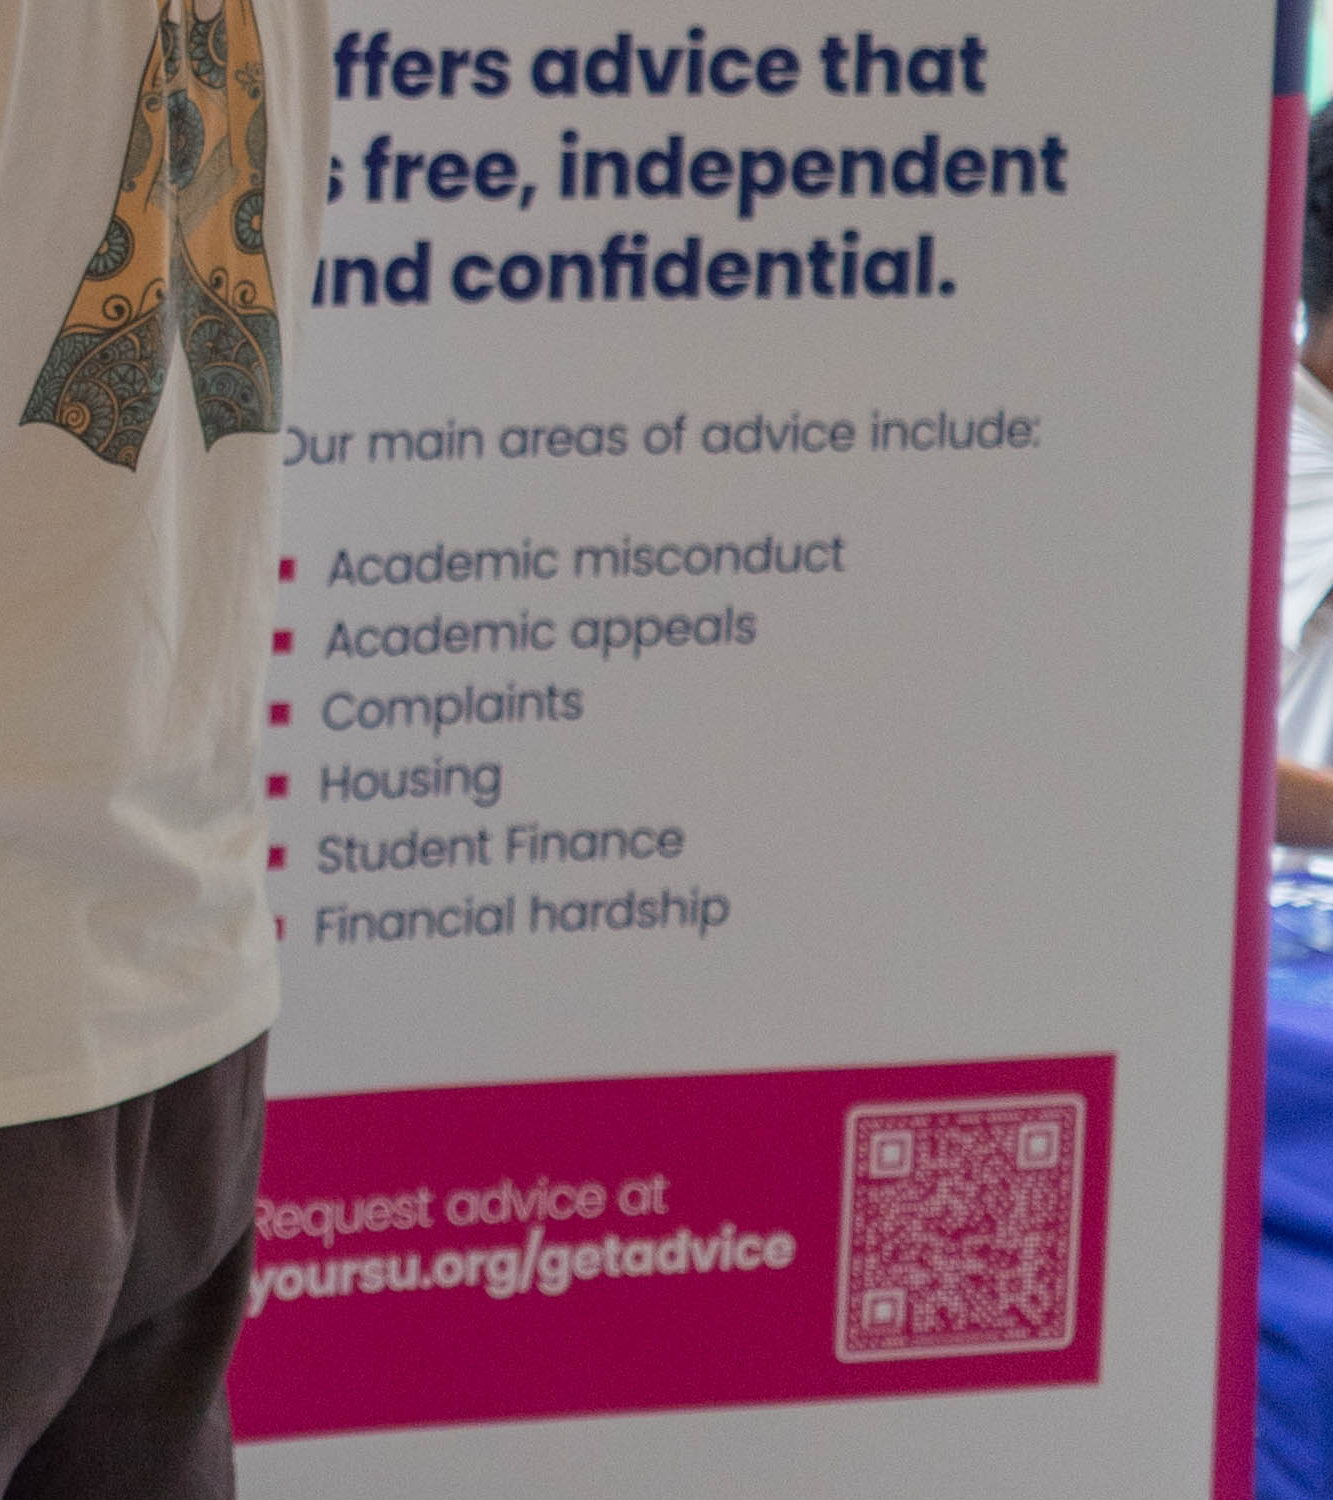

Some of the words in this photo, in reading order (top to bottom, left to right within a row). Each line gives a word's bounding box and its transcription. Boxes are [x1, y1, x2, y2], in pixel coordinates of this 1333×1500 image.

[334, 31, 510, 99] ffers
[531, 27, 800, 96] advice
[820, 33, 987, 95] that
[363, 135, 536, 210] free,
[561, 130, 1067, 220] independent
[451, 229, 955, 302] confidential.
[368, 420, 484, 462] main
[499, 423, 628, 458] areas
[643, 413, 687, 455] of
[701, 412, 856, 455] advice
[871, 410, 1039, 451] include:
[328, 538, 558, 587] Academic
[574, 534, 845, 577] misconduct
[325, 610, 556, 659] Academic
[570, 606, 756, 661] appeals
[321, 683, 584, 738] Complaints
[320, 756, 502, 808] Housing
[318, 828, 490, 874] Student
[506, 822, 685, 863] Finance
[315, 896, 515, 945] Financial
[530, 887, 730, 939] hardship
[254, 1187, 434, 1248] Request
[446, 1177, 606, 1226] advice
[617, 1174, 670, 1216] at
[246, 1223, 796, 1318] yoursu.org/getadvice
